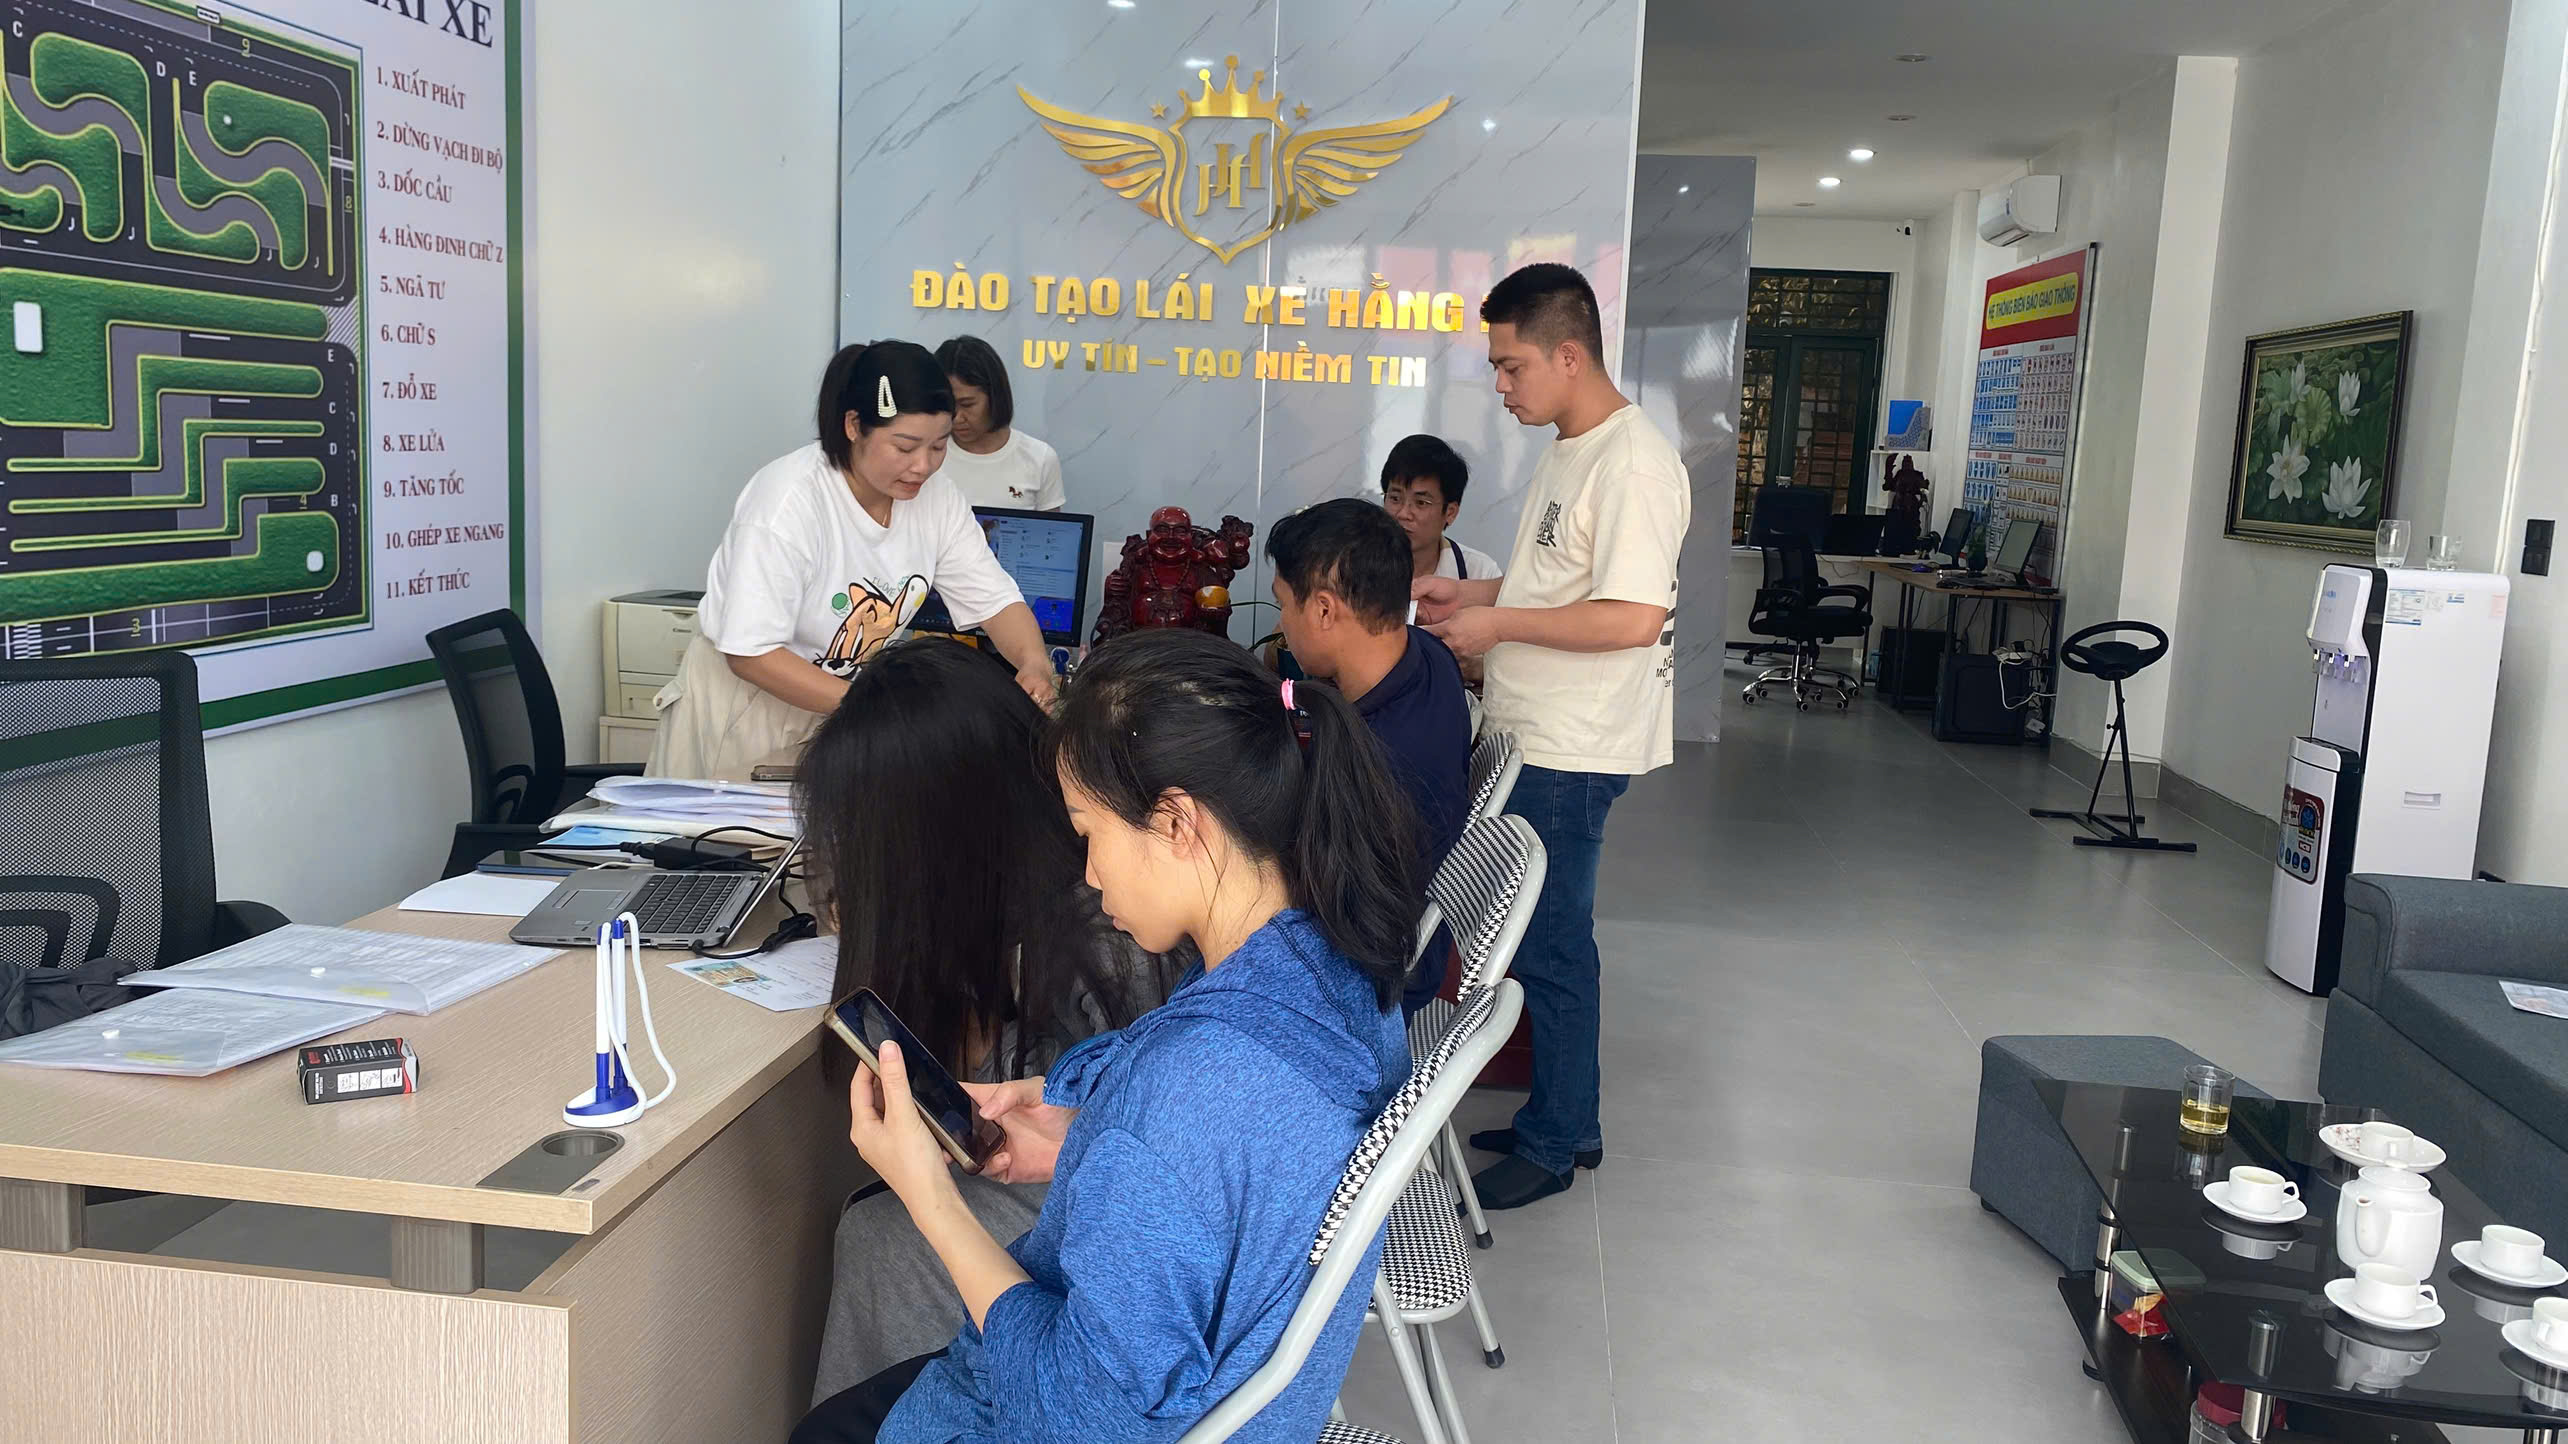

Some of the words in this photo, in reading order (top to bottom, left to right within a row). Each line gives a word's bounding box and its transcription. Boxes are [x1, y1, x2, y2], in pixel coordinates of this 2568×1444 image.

[12, 20, 24, 38] C
[156, 61, 166, 77] D
[188, 70, 198, 87] E
[377, 66, 389, 87] 1.
[392, 68, 429, 98] XUẤT
[432, 84, 467, 110] PHÁT
[376, 120, 390, 141] 2.
[393, 121, 430, 152] DỪNG
[433, 135, 469, 162] VẠCH
[487, 147, 503, 175] BỘ
[377, 170, 391, 190] 3.
[393, 168, 423, 198] DỐC
[378, 225, 392, 245] 4.
[395, 224, 433, 252] HÀNG
[469, 240, 494, 262] CHỮ
[495, 246, 504, 264] Z
[380, 275, 393, 294] 5.
[427, 280, 446, 301] TƯ
[908, 261, 1010, 313] ĐÀO
[1028, 275, 1122, 325] TẠO
[1135, 271, 1214, 322] LÁI
[1243, 284, 1307, 327] XE
[1327, 271, 1465, 334] HẰNG
[381, 323, 394, 343] 6.
[397, 321, 425, 345] CHỮ
[427, 327, 436, 346] S
[327, 348, 335, 362] E
[1023, 338, 1071, 370] UY
[1080, 337, 1139, 374] TÍN
[1173, 346, 1243, 383] TẠO
[1254, 340, 1353, 384] NIỀM
[1367, 355, 1427, 388] TIN
[382, 381, 395, 400] 7.
[420, 382, 437, 401] XE
[329, 402, 337, 414] C
[329, 442, 338, 456] D
[383, 434, 396, 453] 8.
[398, 434, 417, 452] XE
[383, 480, 396, 499] 9.
[439, 469, 465, 496] TỐC
[330, 494, 339, 507] B
[385, 531, 405, 550] 10.
[407, 522, 442, 548] GHÉP
[444, 526, 461, 545] XE
[463, 523, 505, 543] NGANG
[386, 581, 406, 600] 11.
[408, 568, 434, 596] KẾT
[437, 567, 471, 592] THÚC
[131, 618, 140, 633] 3
